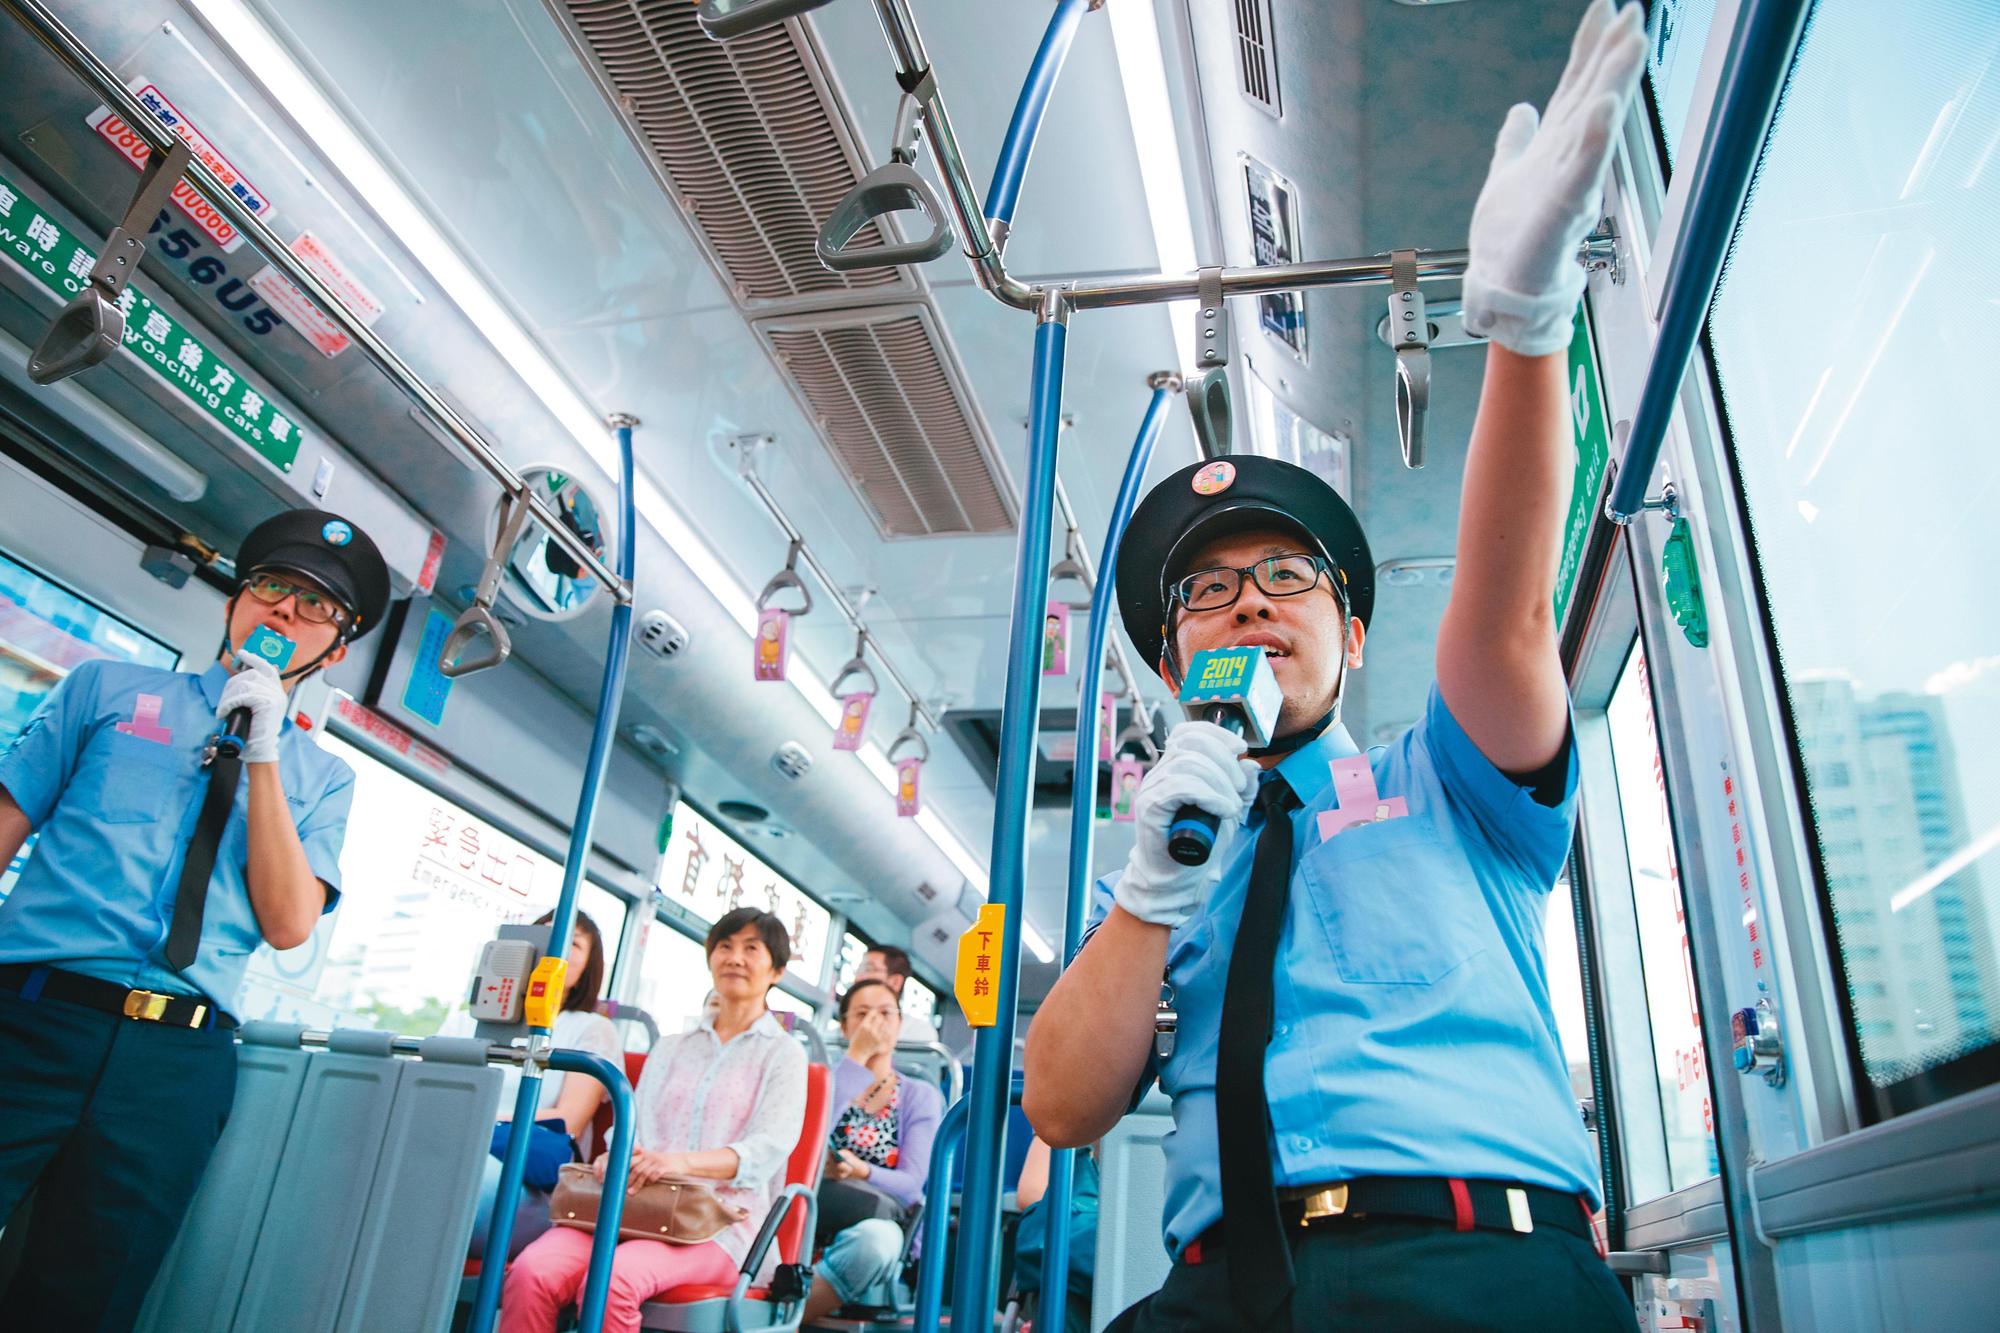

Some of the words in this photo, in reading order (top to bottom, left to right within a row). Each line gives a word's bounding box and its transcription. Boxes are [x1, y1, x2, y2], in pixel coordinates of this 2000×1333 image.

[224, 406, 265, 445] cars.
[1202, 656, 1248, 679] 2014
[974, 931, 993, 997] 下車鈴
